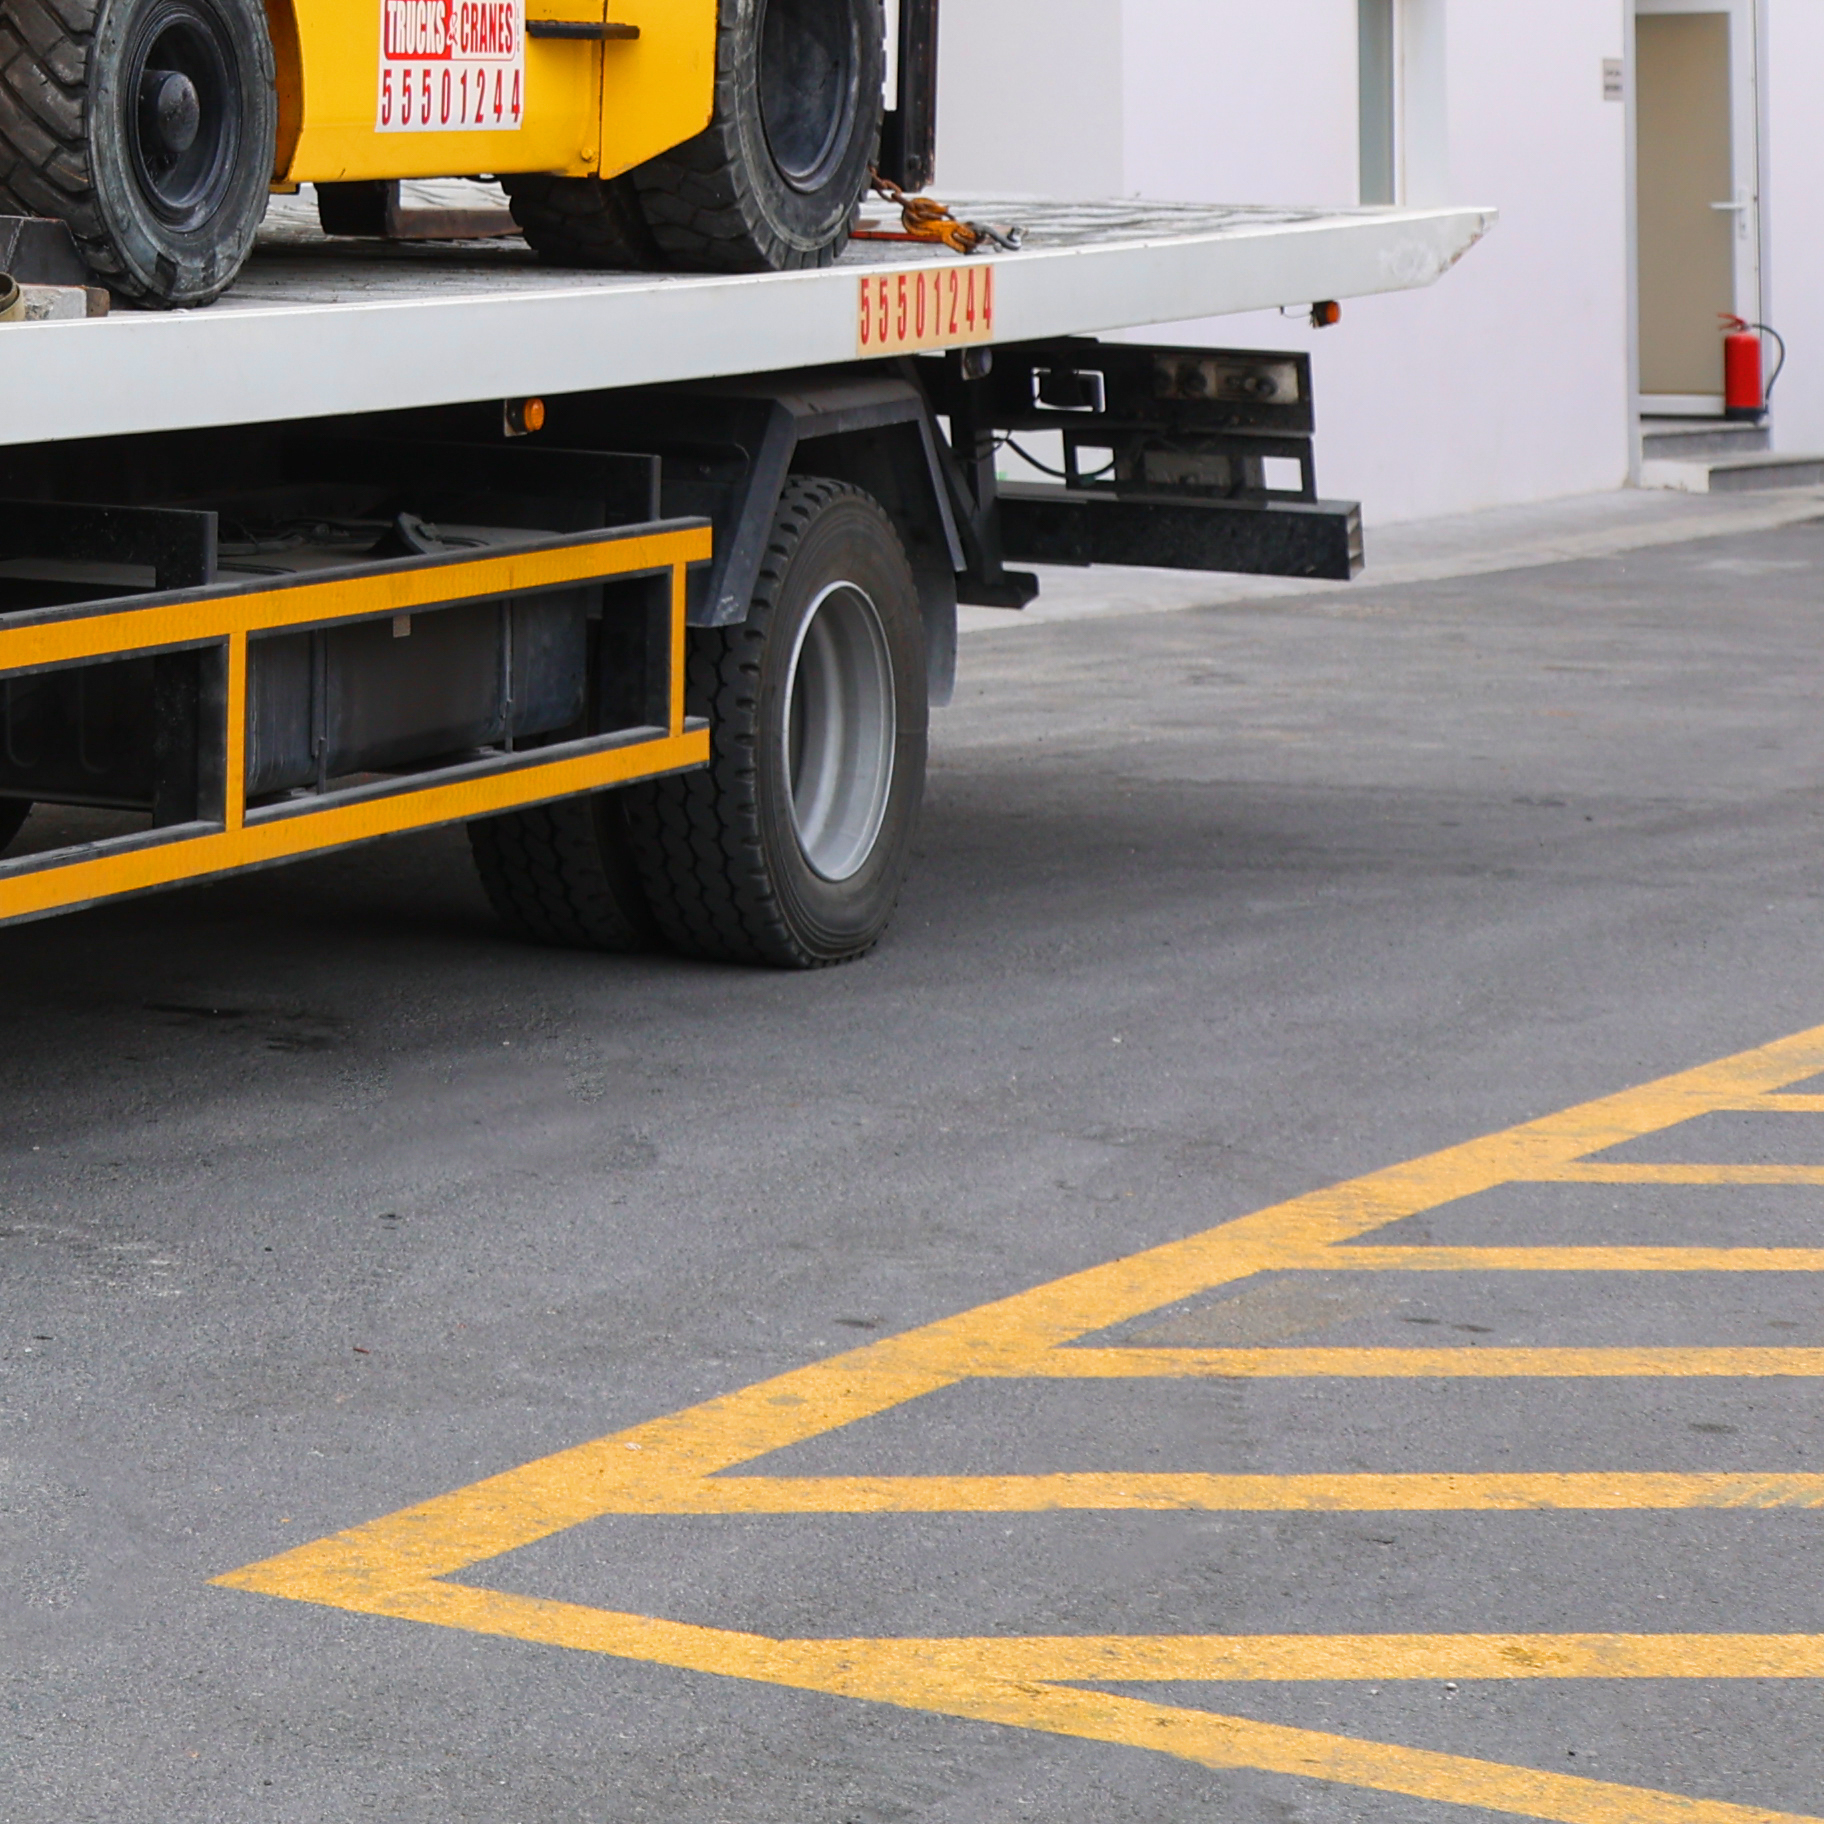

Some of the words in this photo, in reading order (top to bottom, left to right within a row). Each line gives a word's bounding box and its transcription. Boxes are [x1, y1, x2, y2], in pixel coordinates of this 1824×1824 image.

[387, 0, 447, 55] TRUCKS
[446, 11, 458, 46] &
[460, 1, 514, 54] CRANES
[381, 68, 521, 126] 55501244
[860, 266, 992, 345] 55501244
